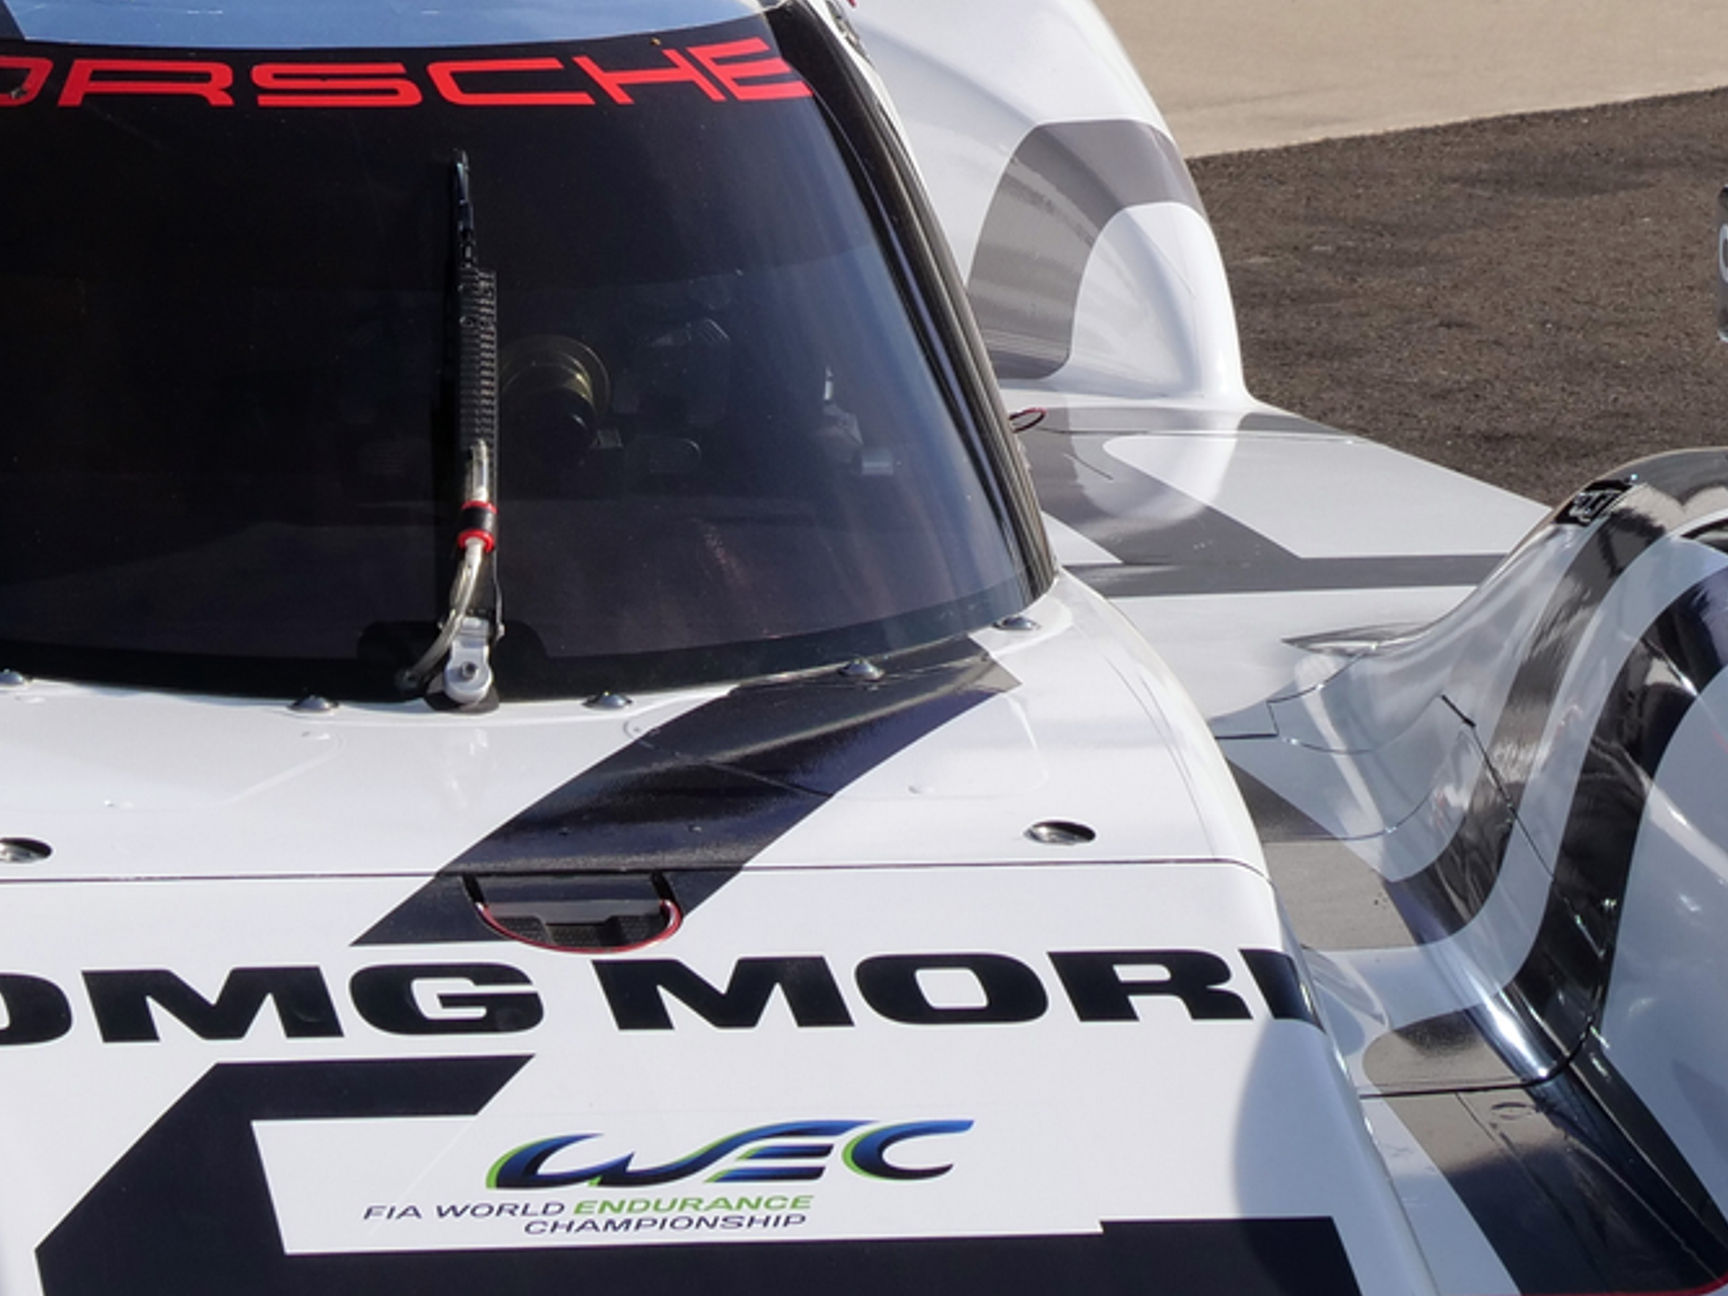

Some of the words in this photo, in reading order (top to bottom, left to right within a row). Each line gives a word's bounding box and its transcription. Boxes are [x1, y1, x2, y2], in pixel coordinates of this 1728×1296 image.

[591, 948, 1326, 1034] MORI
[486, 1119, 975, 1190] WEC
[364, 1204, 423, 1220] FIA
[435, 1200, 565, 1219] WORLD
[573, 1194, 814, 1215] ENDURANCE
[524, 1213, 807, 1235] CHAMPIONSHIP
